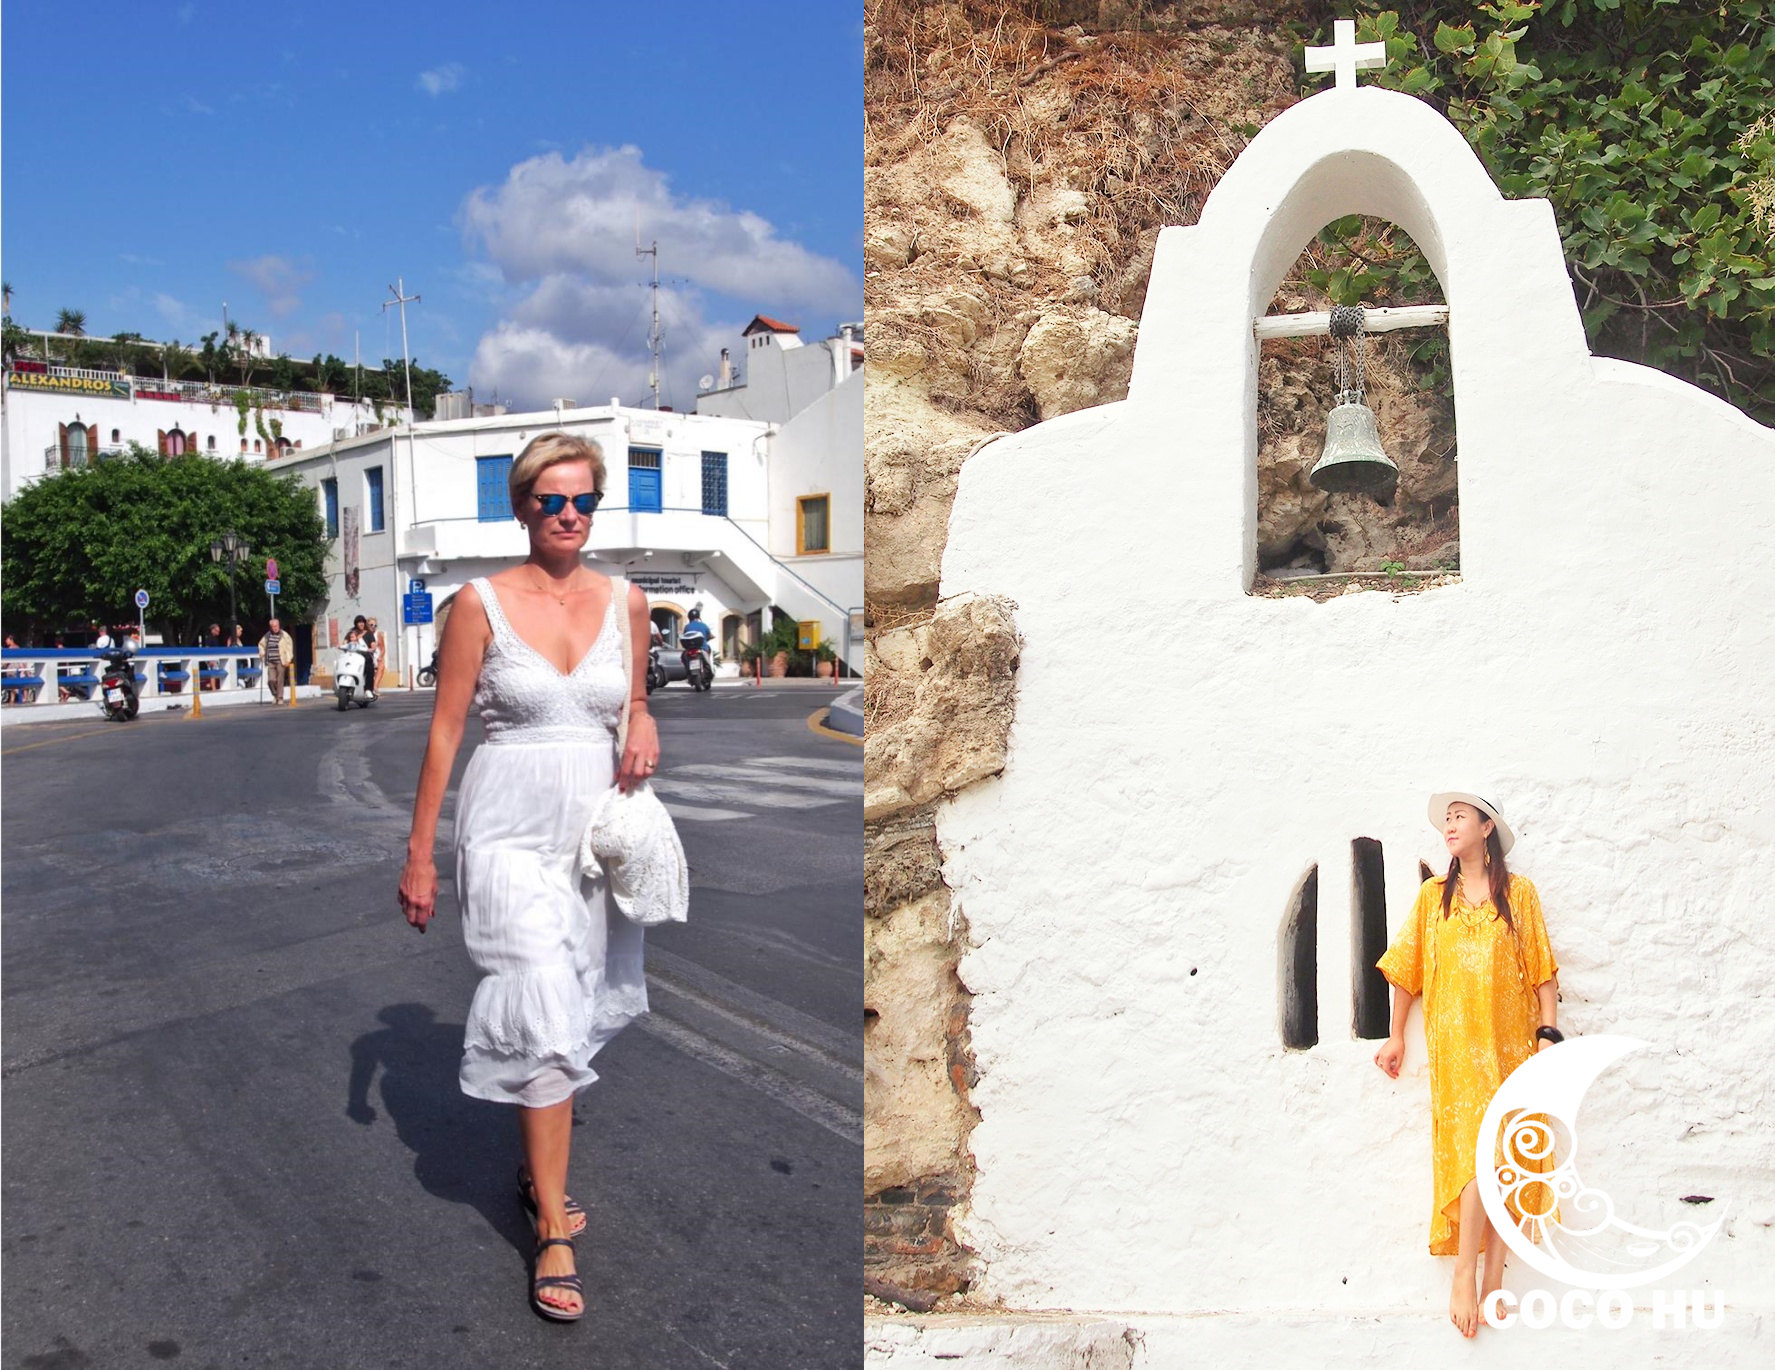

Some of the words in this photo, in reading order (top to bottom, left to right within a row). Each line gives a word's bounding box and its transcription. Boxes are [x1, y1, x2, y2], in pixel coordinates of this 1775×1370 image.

[9, 373, 112, 391] ALEXANDROS
[412, 581, 423, 593] P
[638, 585, 674, 594] formation
[674, 585, 695, 594] office
